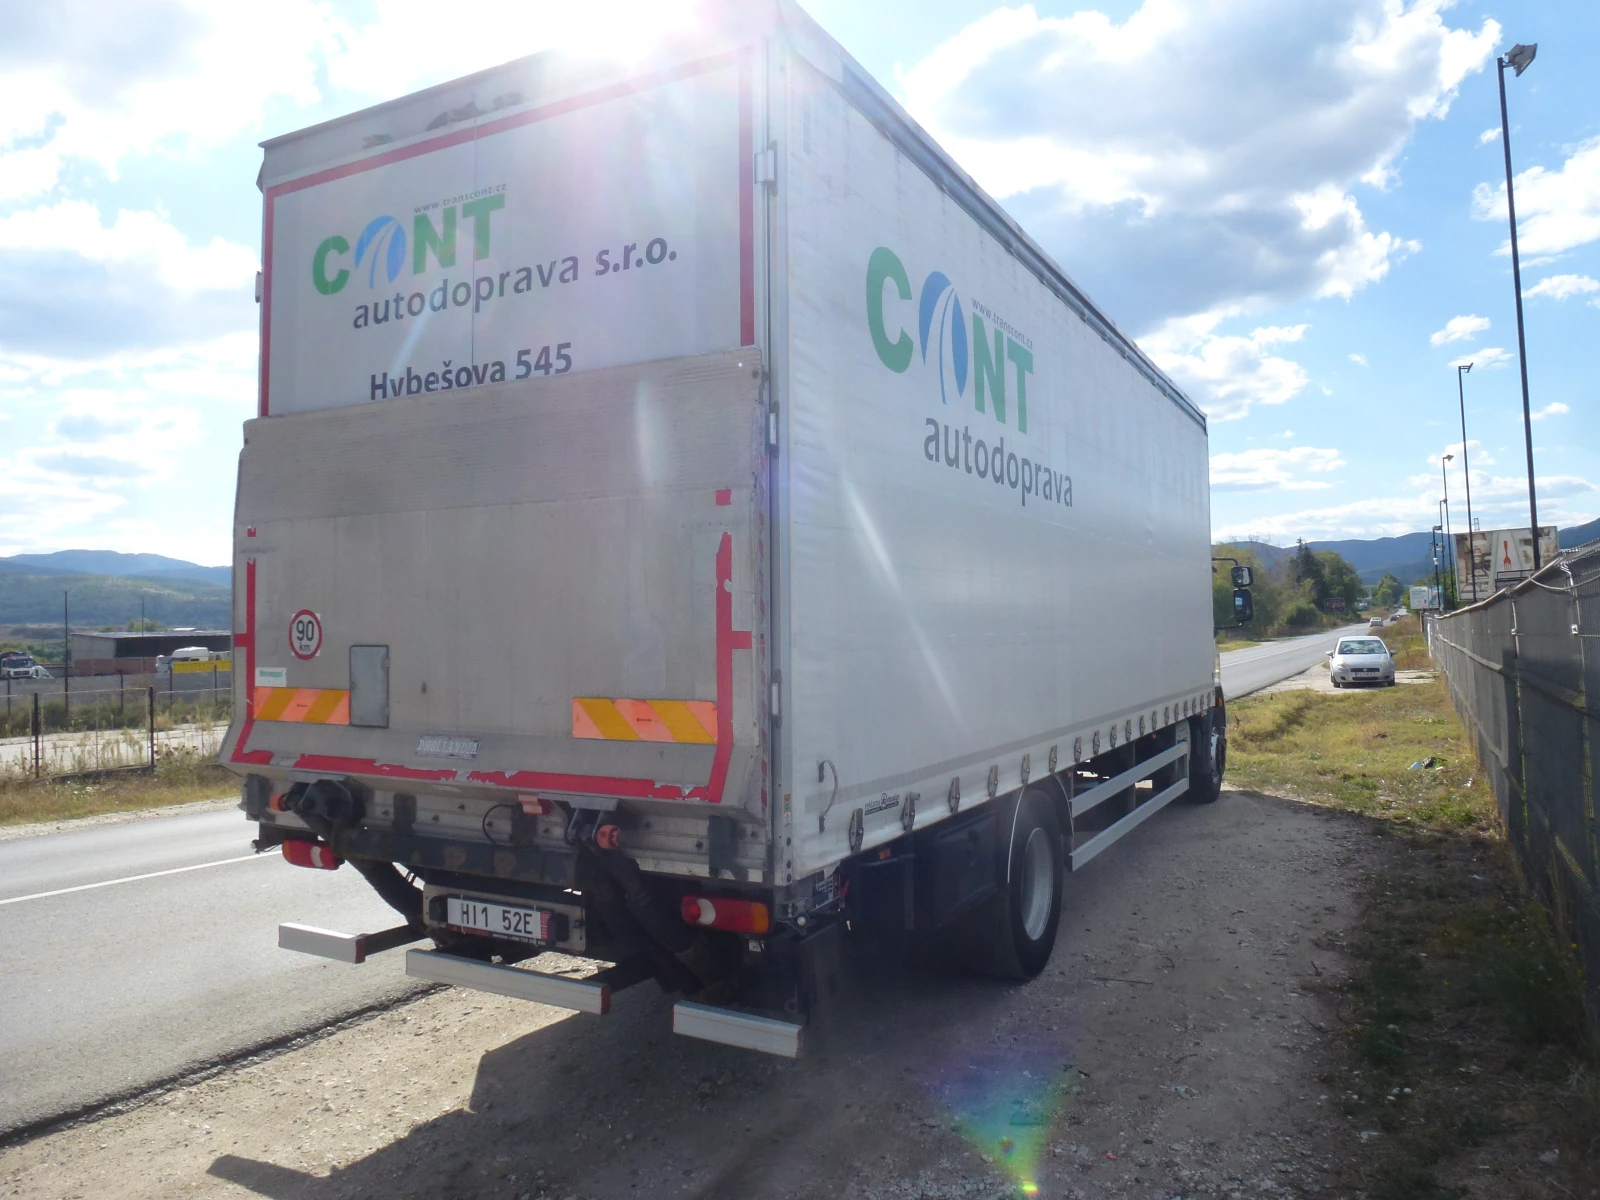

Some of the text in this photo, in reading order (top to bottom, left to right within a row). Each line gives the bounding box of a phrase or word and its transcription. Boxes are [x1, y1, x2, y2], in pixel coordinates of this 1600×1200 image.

[414, 183, 507, 214] www.transcont.cz
[353, 237, 677, 329] autodoprava s.r.o.
[971, 297, 1034, 350] www.transcont.cz
[515, 342, 572, 380] 545
[923, 417, 1073, 508] autodoprava
[296, 620, 315, 641] 90
[299, 641, 311, 652] km
[502, 909, 533, 935] 52E
